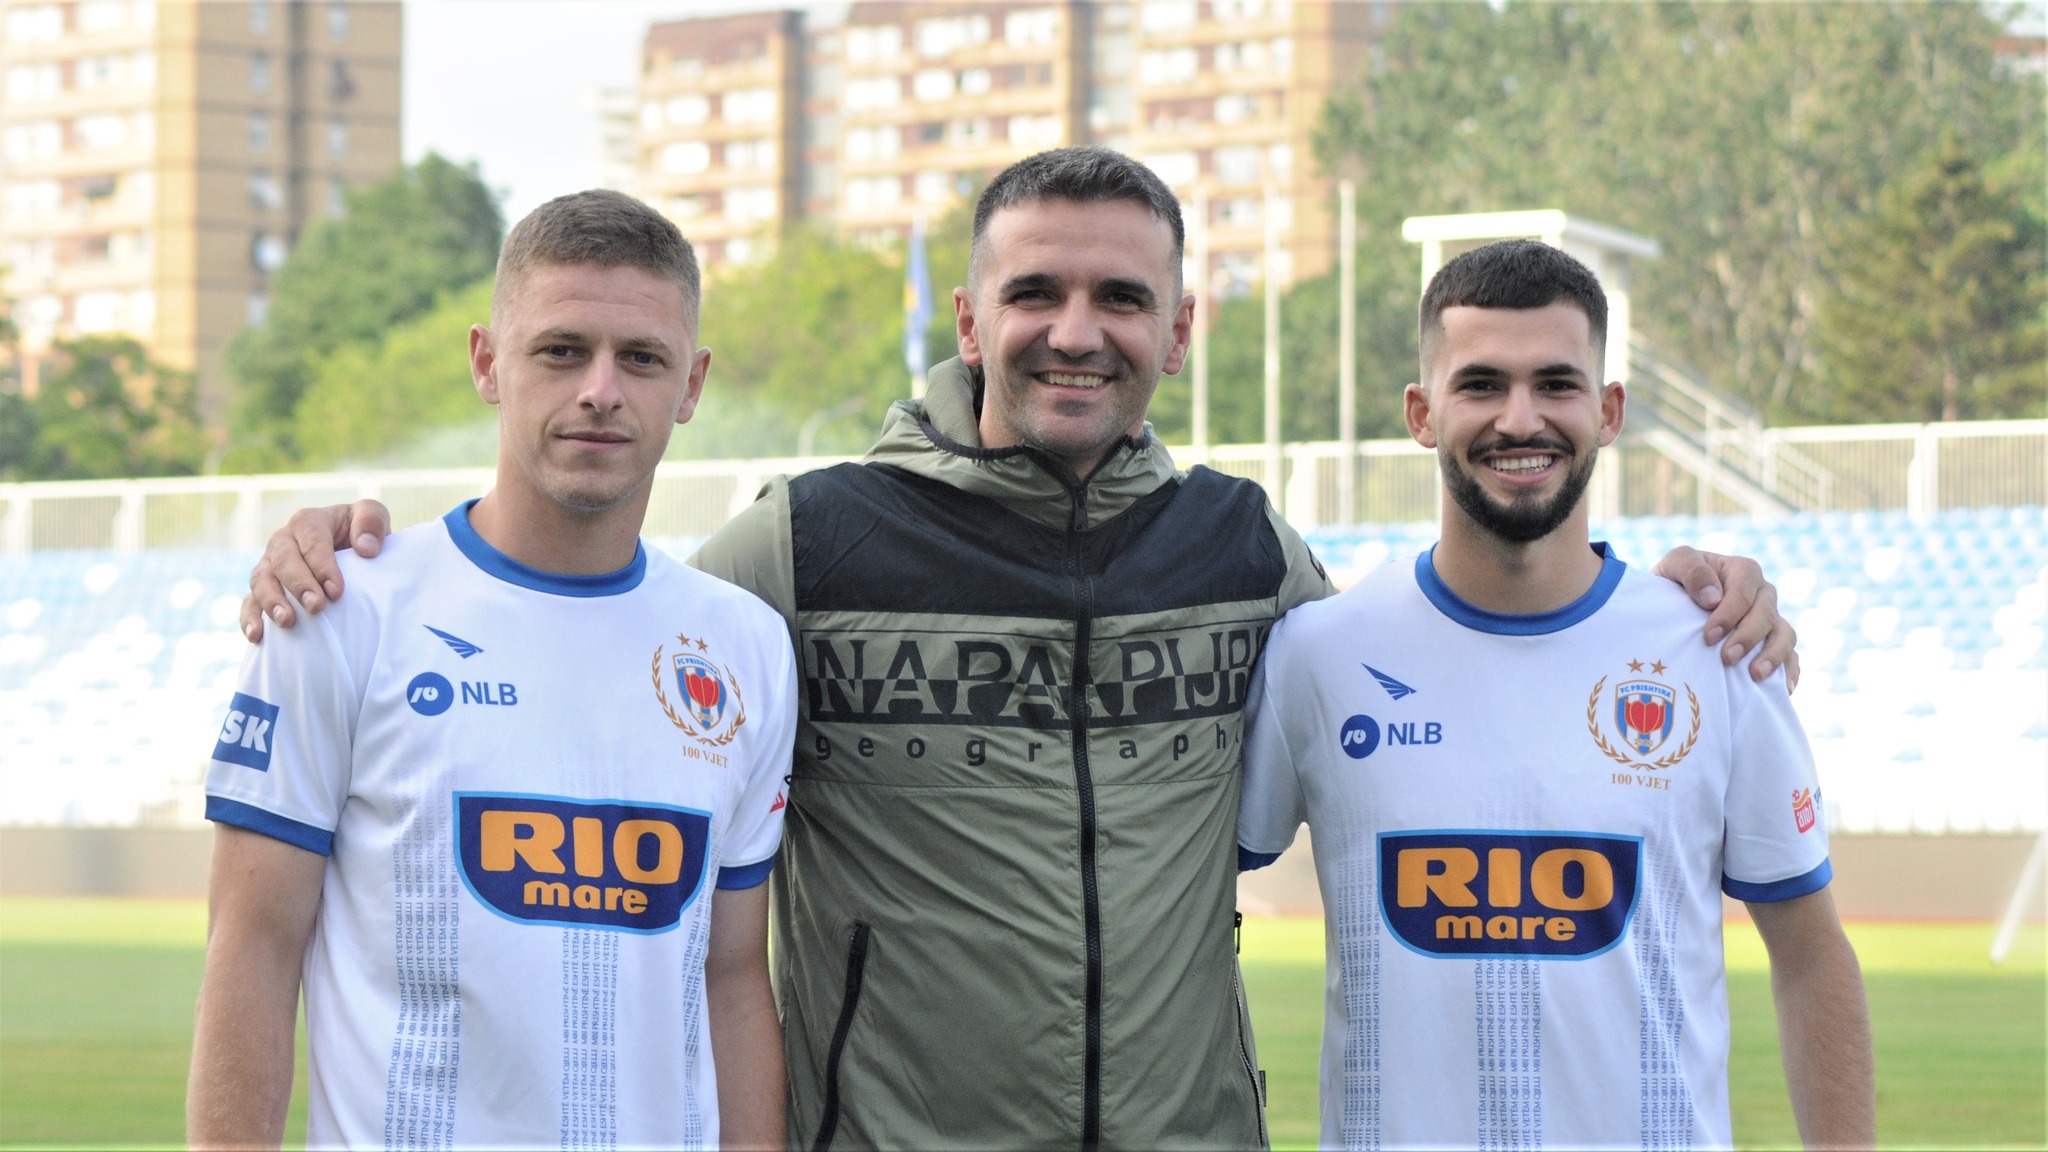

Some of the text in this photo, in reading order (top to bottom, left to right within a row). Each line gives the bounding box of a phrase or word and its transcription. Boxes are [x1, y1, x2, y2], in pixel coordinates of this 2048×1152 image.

[461, 681, 518, 706] NLB
[1620, 685, 1671, 698] FC PRISHTINA
[1387, 722, 1443, 746] NLB
[682, 745, 729, 768] 100 VJET
[1611, 773, 1671, 791] 100 VJET
[481, 810, 684, 884] RIO
[1396, 847, 1614, 911] RIO
[523, 881, 649, 915] mare
[1435, 914, 1577, 942] mare
